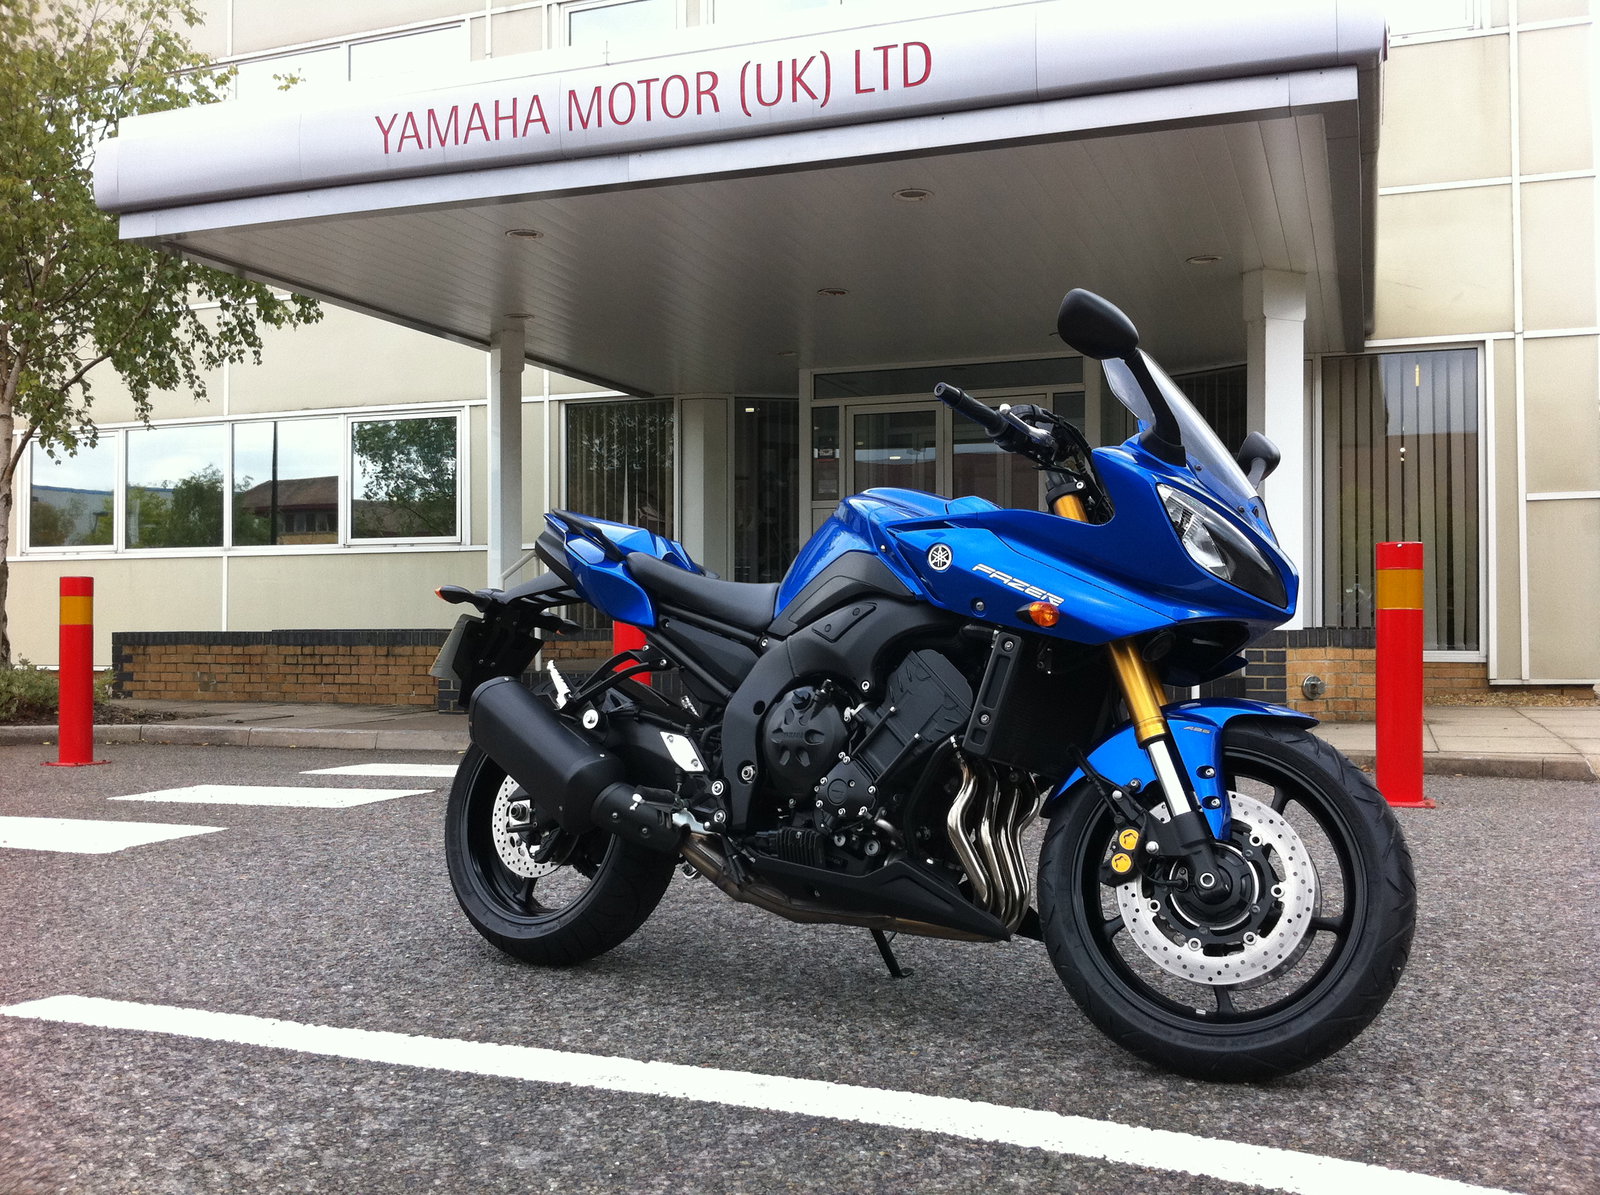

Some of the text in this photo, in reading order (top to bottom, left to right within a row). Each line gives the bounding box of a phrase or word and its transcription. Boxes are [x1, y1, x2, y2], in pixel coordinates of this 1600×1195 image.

[374, 41, 933, 155] YAMAHA MOTOR (UK) LTD
[971, 563, 1065, 607] FAZER
